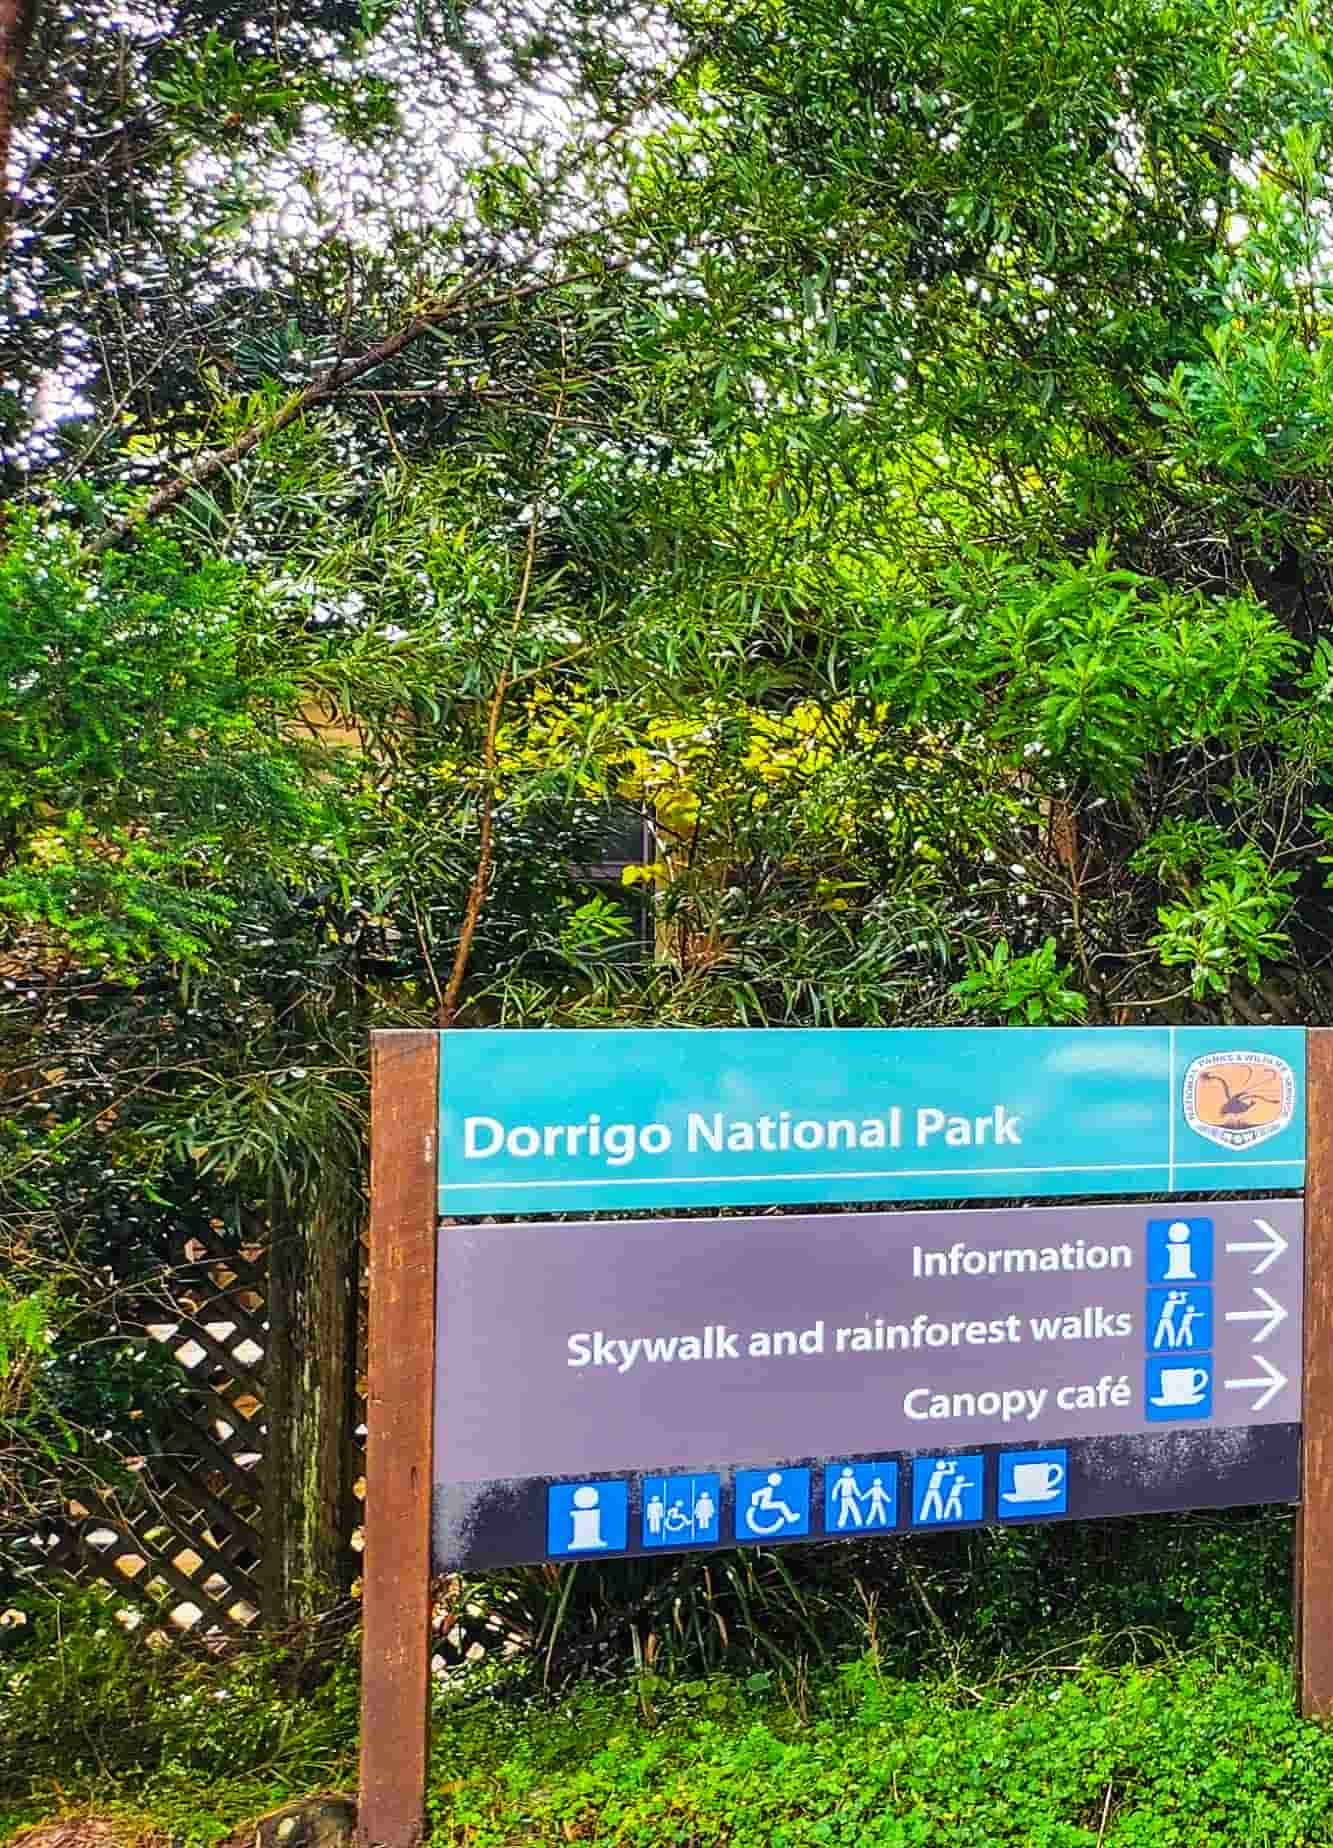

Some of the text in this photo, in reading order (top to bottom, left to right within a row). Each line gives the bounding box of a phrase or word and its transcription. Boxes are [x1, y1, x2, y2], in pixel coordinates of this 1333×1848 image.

[463, 1104, 1020, 1165] Dorrigo National Park
[912, 1239, 1133, 1277] Information
[567, 1306, 1132, 1374] Skywalk and rainforest walks
[903, 1375, 1132, 1423] Canopy café
